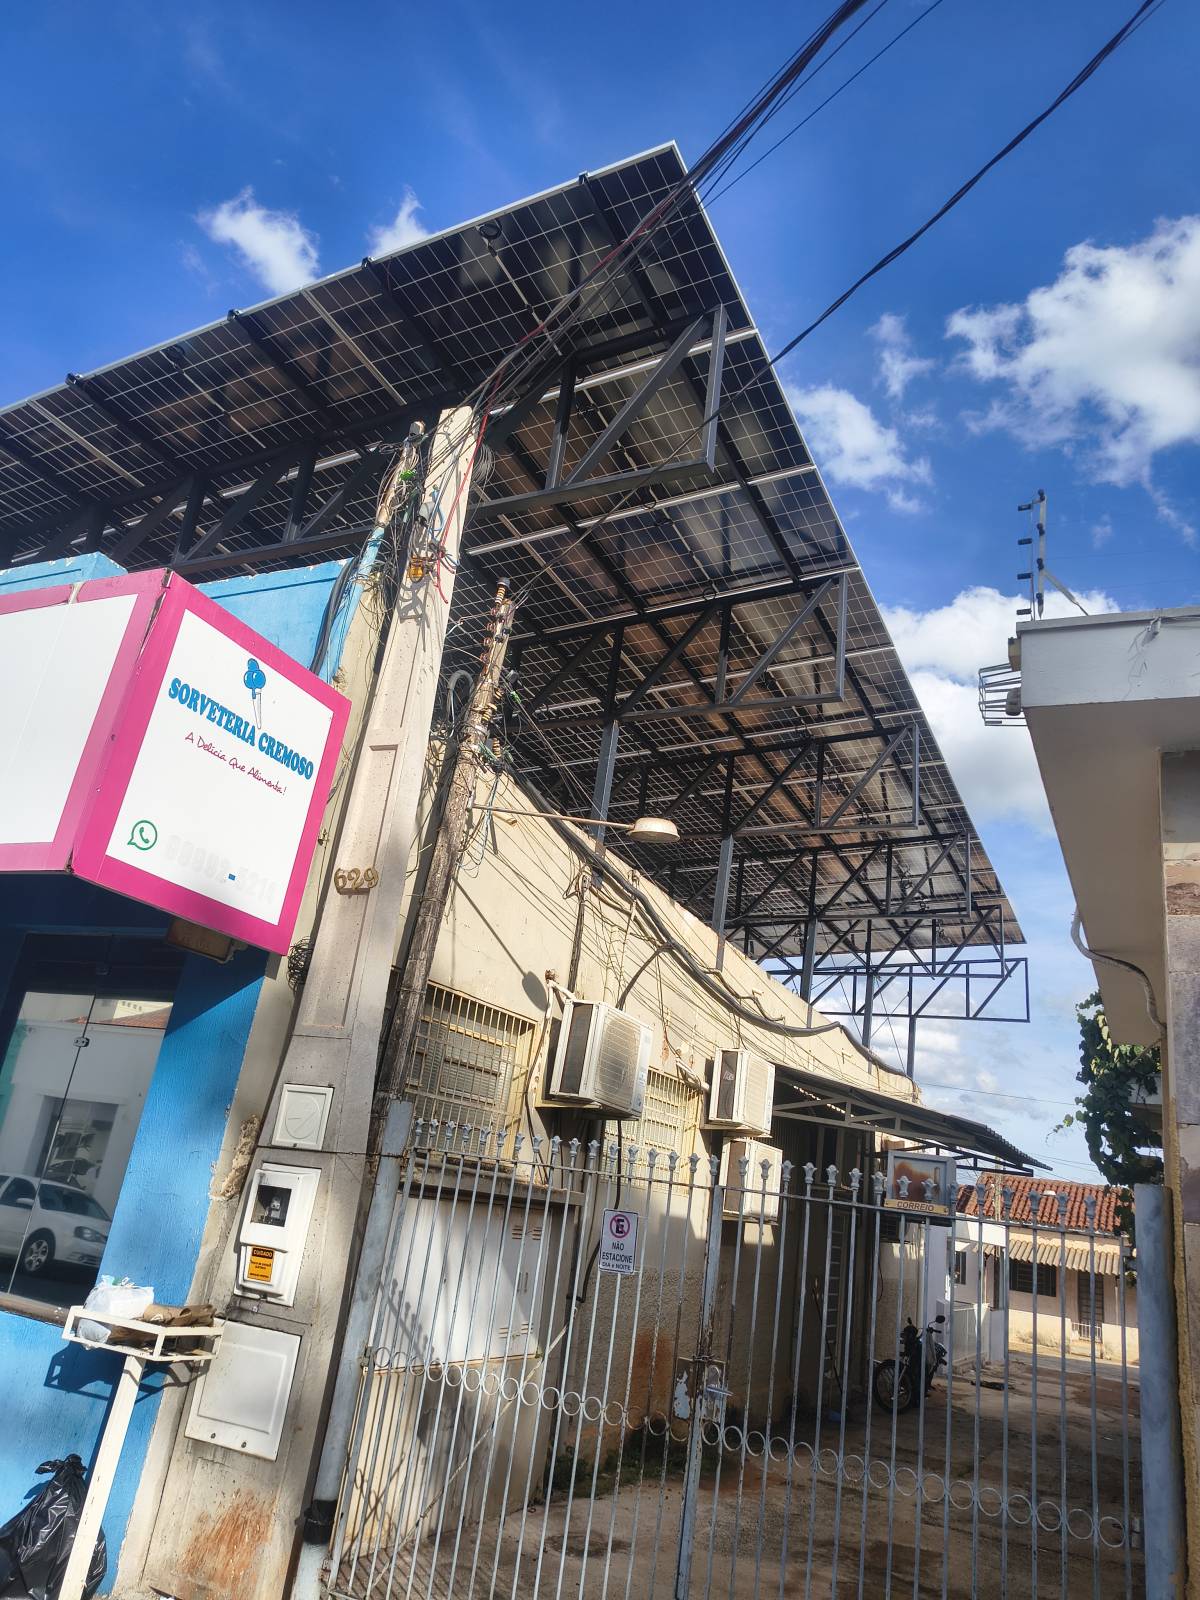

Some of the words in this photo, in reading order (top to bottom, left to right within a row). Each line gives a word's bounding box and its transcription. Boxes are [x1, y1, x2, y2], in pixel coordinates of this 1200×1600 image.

[168, 677, 256, 747] SORVETERIA
[258, 732, 314, 780] CREMOSO
[185, 732, 194, 743] A
[228, 757, 246, 771] Que
[247, 766, 287, 796] Alimenta!
[334, 867, 379, 891] 629
[896, 1201, 935, 1211] CORREIO
[611, 1241, 624, 1251] NÃO
[602, 1251, 632, 1263] ESTACIONE
[616, 1263, 631, 1271] NOITE
